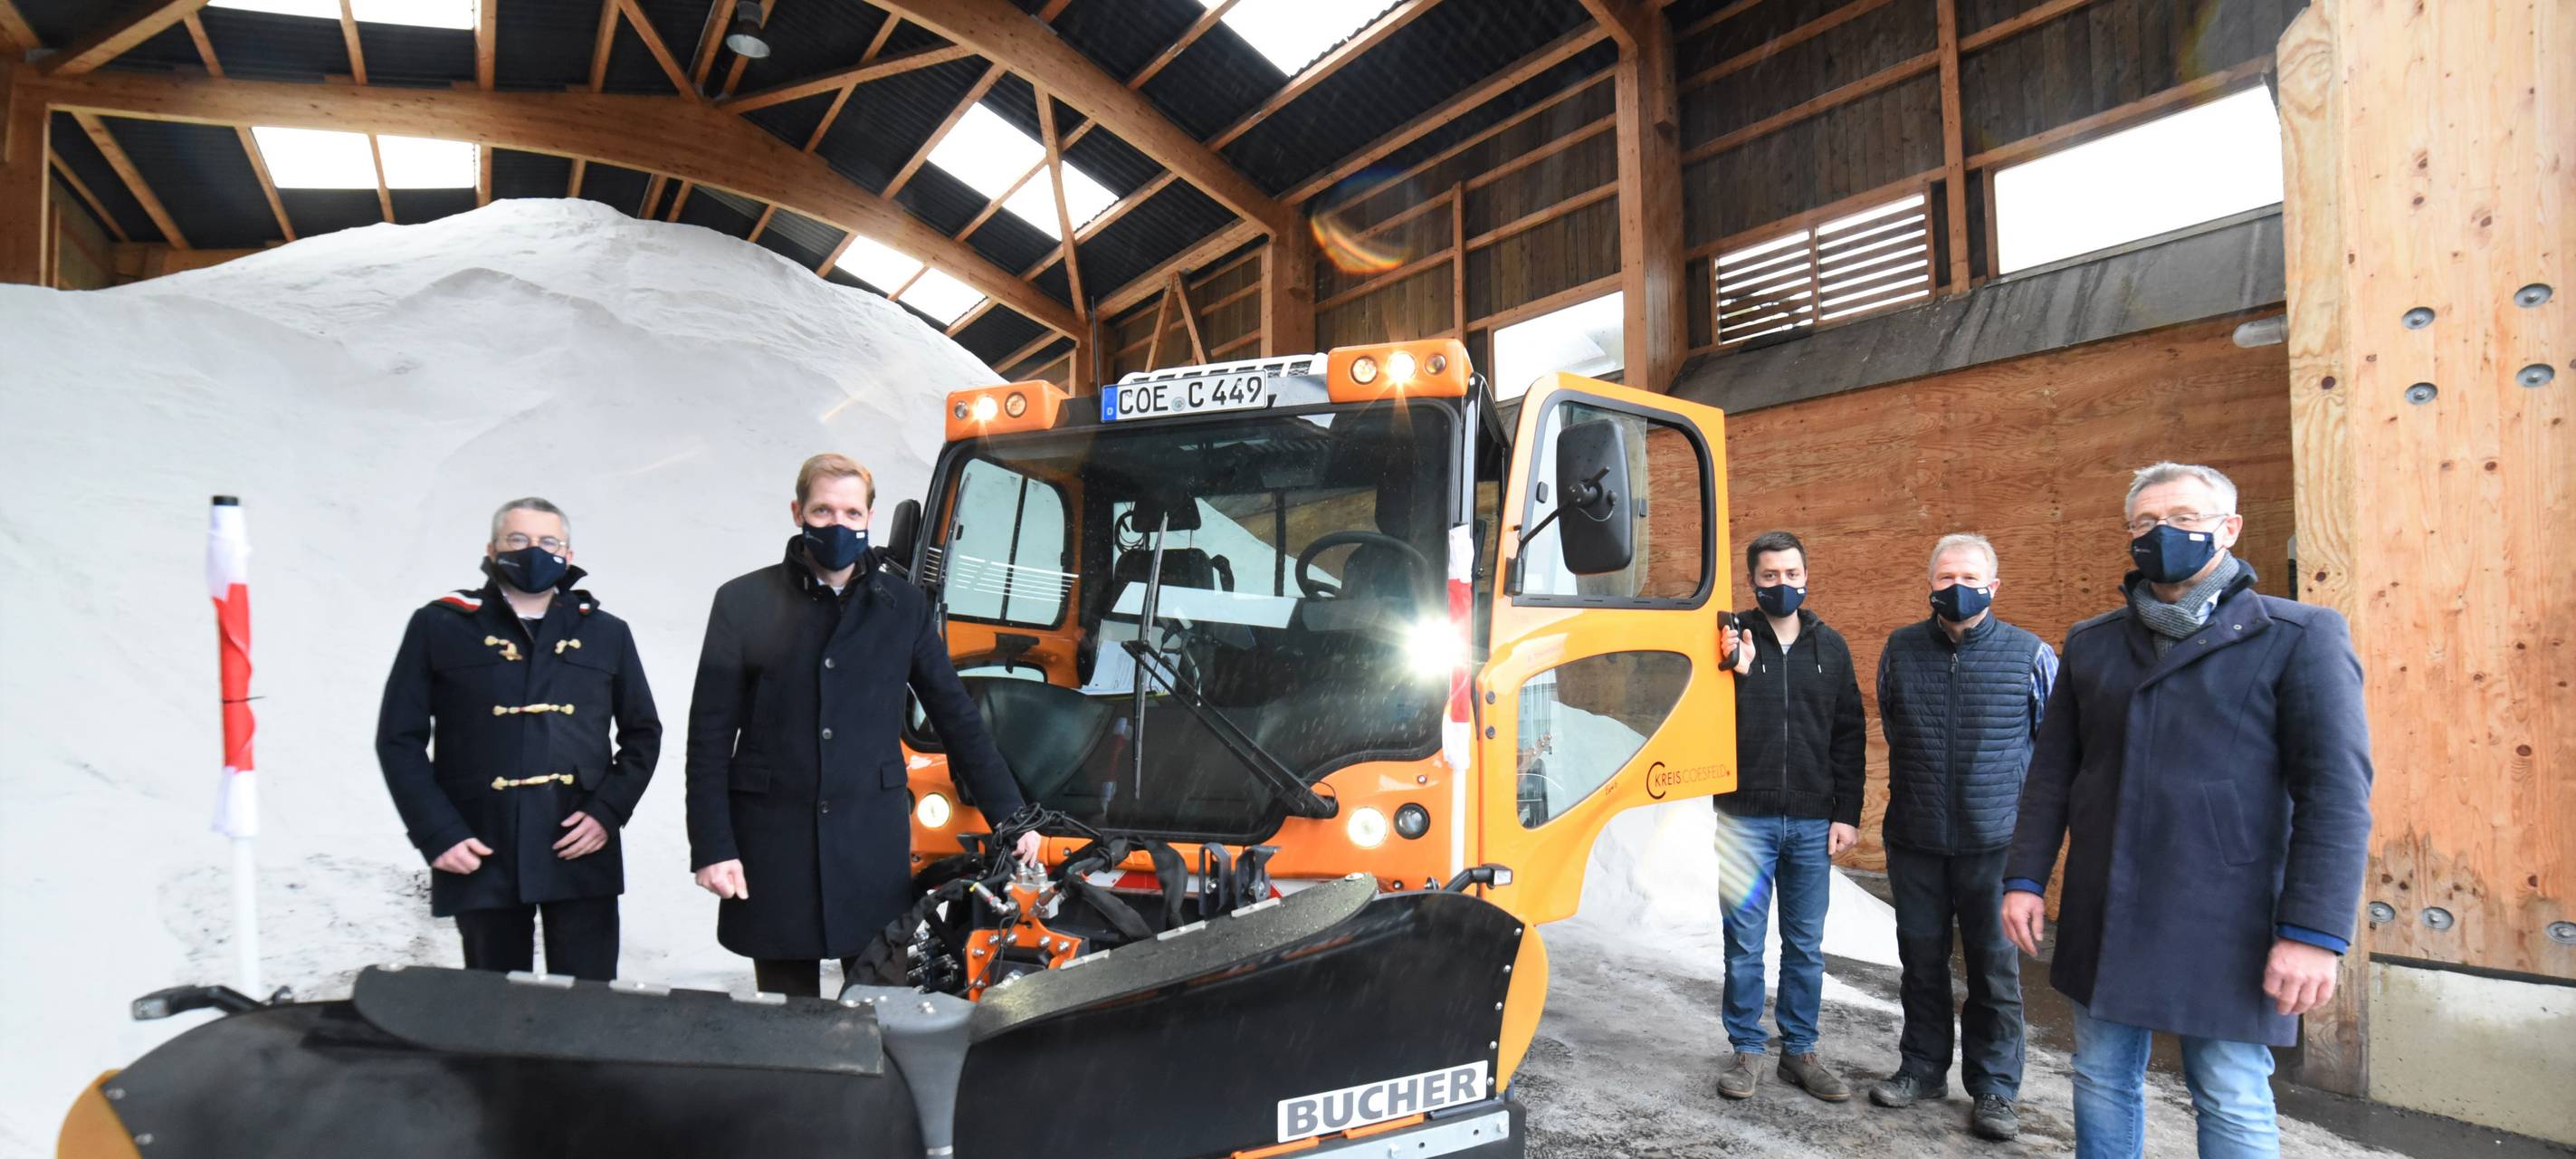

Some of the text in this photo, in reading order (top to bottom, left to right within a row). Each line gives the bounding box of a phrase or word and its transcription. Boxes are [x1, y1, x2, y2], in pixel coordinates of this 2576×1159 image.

[1119, 377, 1263, 415] COE C 449
[1286, 1067, 1477, 1137] BUCHER
